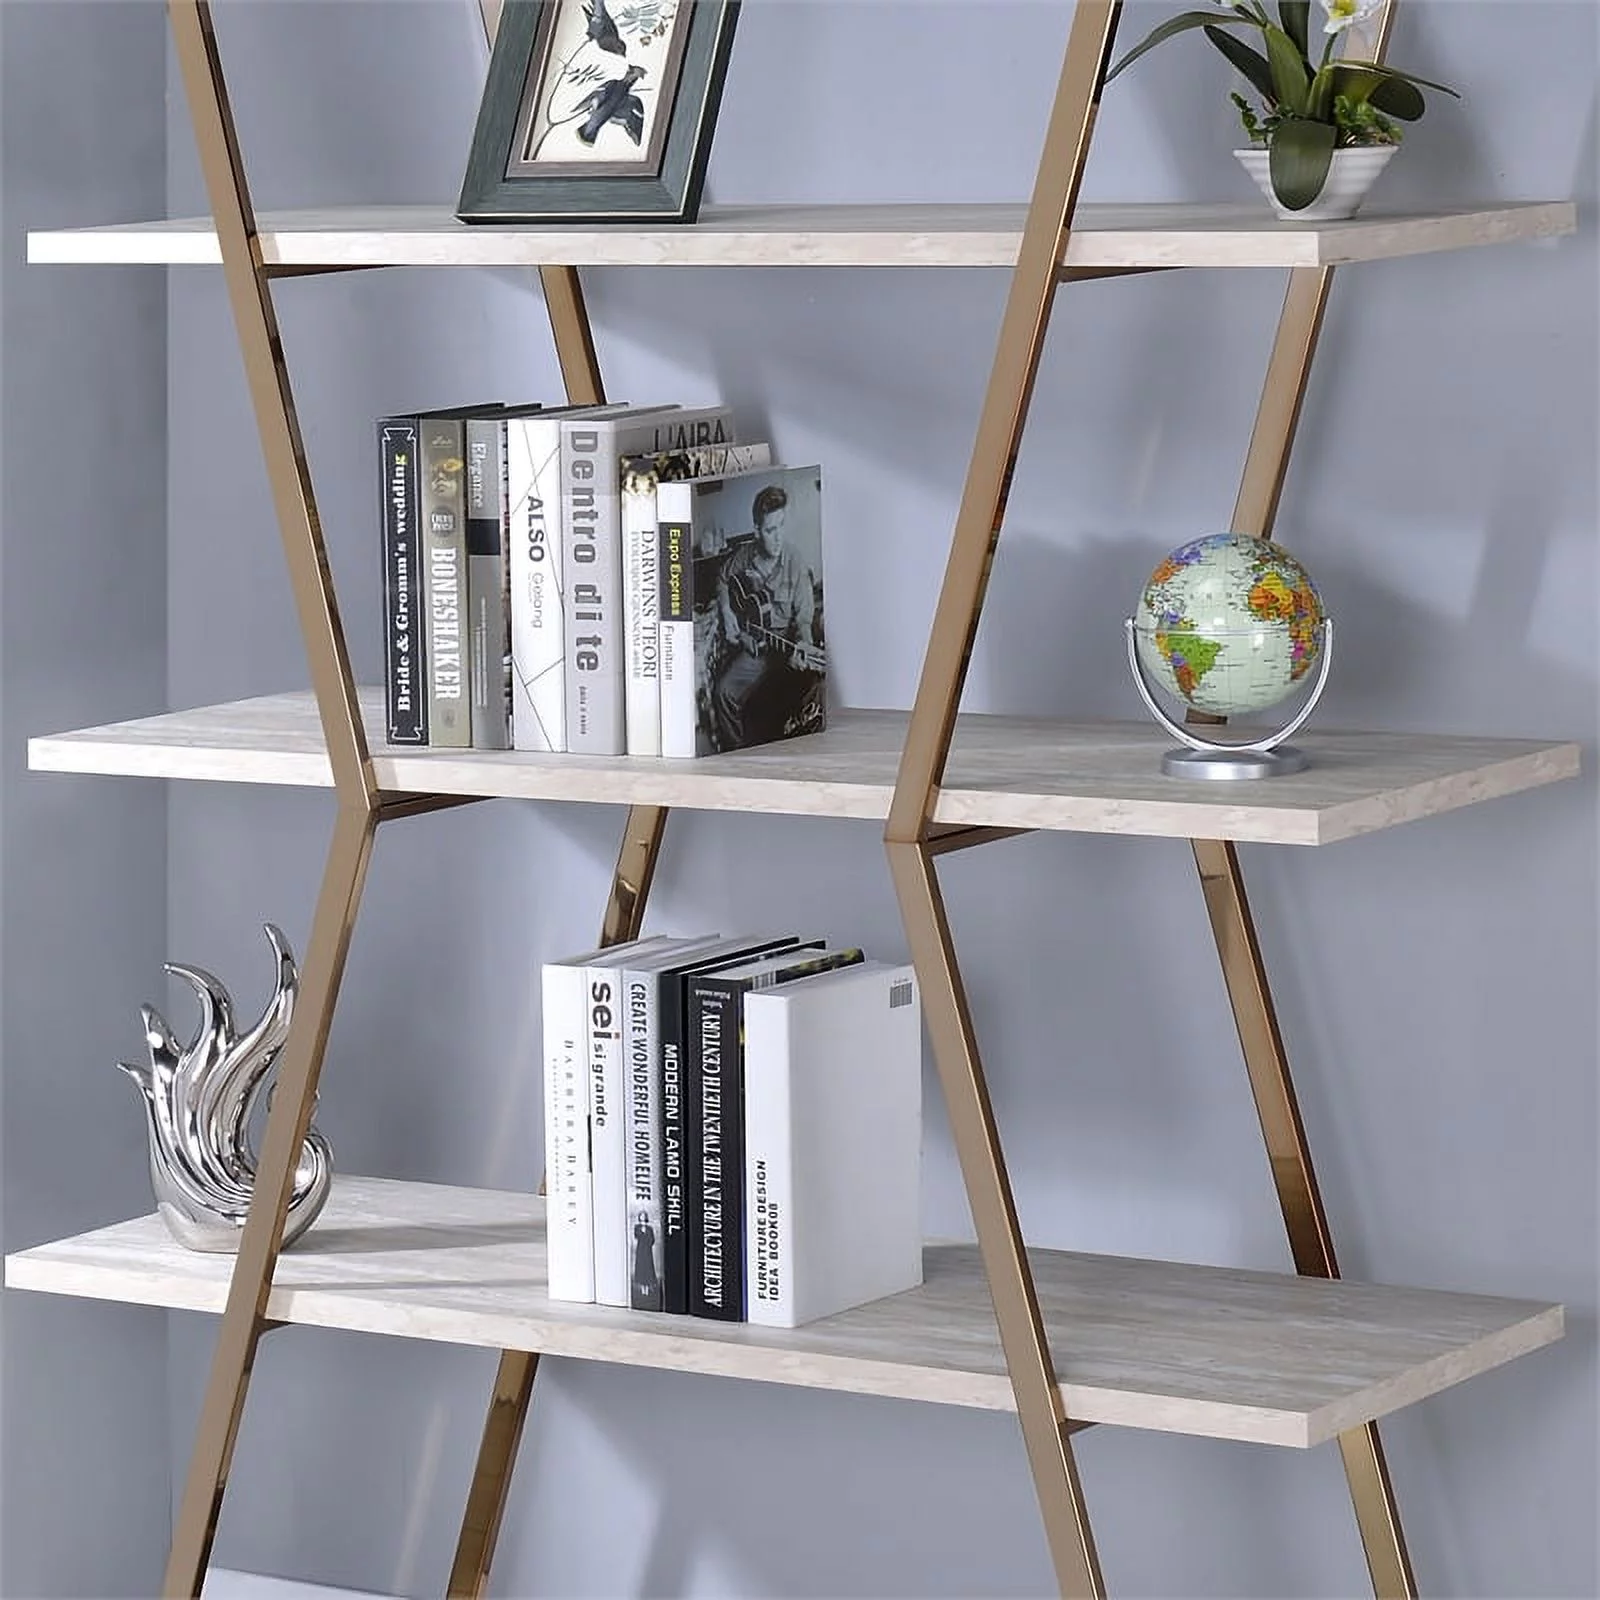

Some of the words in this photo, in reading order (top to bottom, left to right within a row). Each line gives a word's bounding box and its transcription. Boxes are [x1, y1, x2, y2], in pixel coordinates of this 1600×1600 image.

[392, 453, 408, 534] wedding
[571, 431, 599, 564] Dentro
[527, 495, 546, 562] ALSO
[667, 528, 681, 561] Expo
[642, 530, 657, 617] DARWINS
[669, 563, 682, 616] Express
[431, 547, 461, 699] BONESHAKER
[574, 584, 602, 622] di
[396, 633, 410, 653] &
[576, 633, 603, 671] te
[642, 622, 657, 679] TEORI
[396, 655, 411, 712] Bride
[591, 980, 621, 1040] sei
[630, 983, 648, 1032] CREATE
[593, 1043, 606, 1059] si
[702, 1010, 721, 1074] CENTURY
[592, 1063, 608, 1127] grande
[632, 1038, 650, 1125] WONDERFUL
[664, 1043, 681, 1119] MODERN
[702, 1076, 721, 1154] TWENTIETH
[634, 1131, 652, 1201] HOMELIFE
[703, 1156, 721, 1183] THE
[703, 1186, 721, 1200] IN
[756, 1160, 767, 1213] DESIGN
[757, 1217, 768, 1300] FURNITURE
[768, 1268, 780, 1301] IDEA
